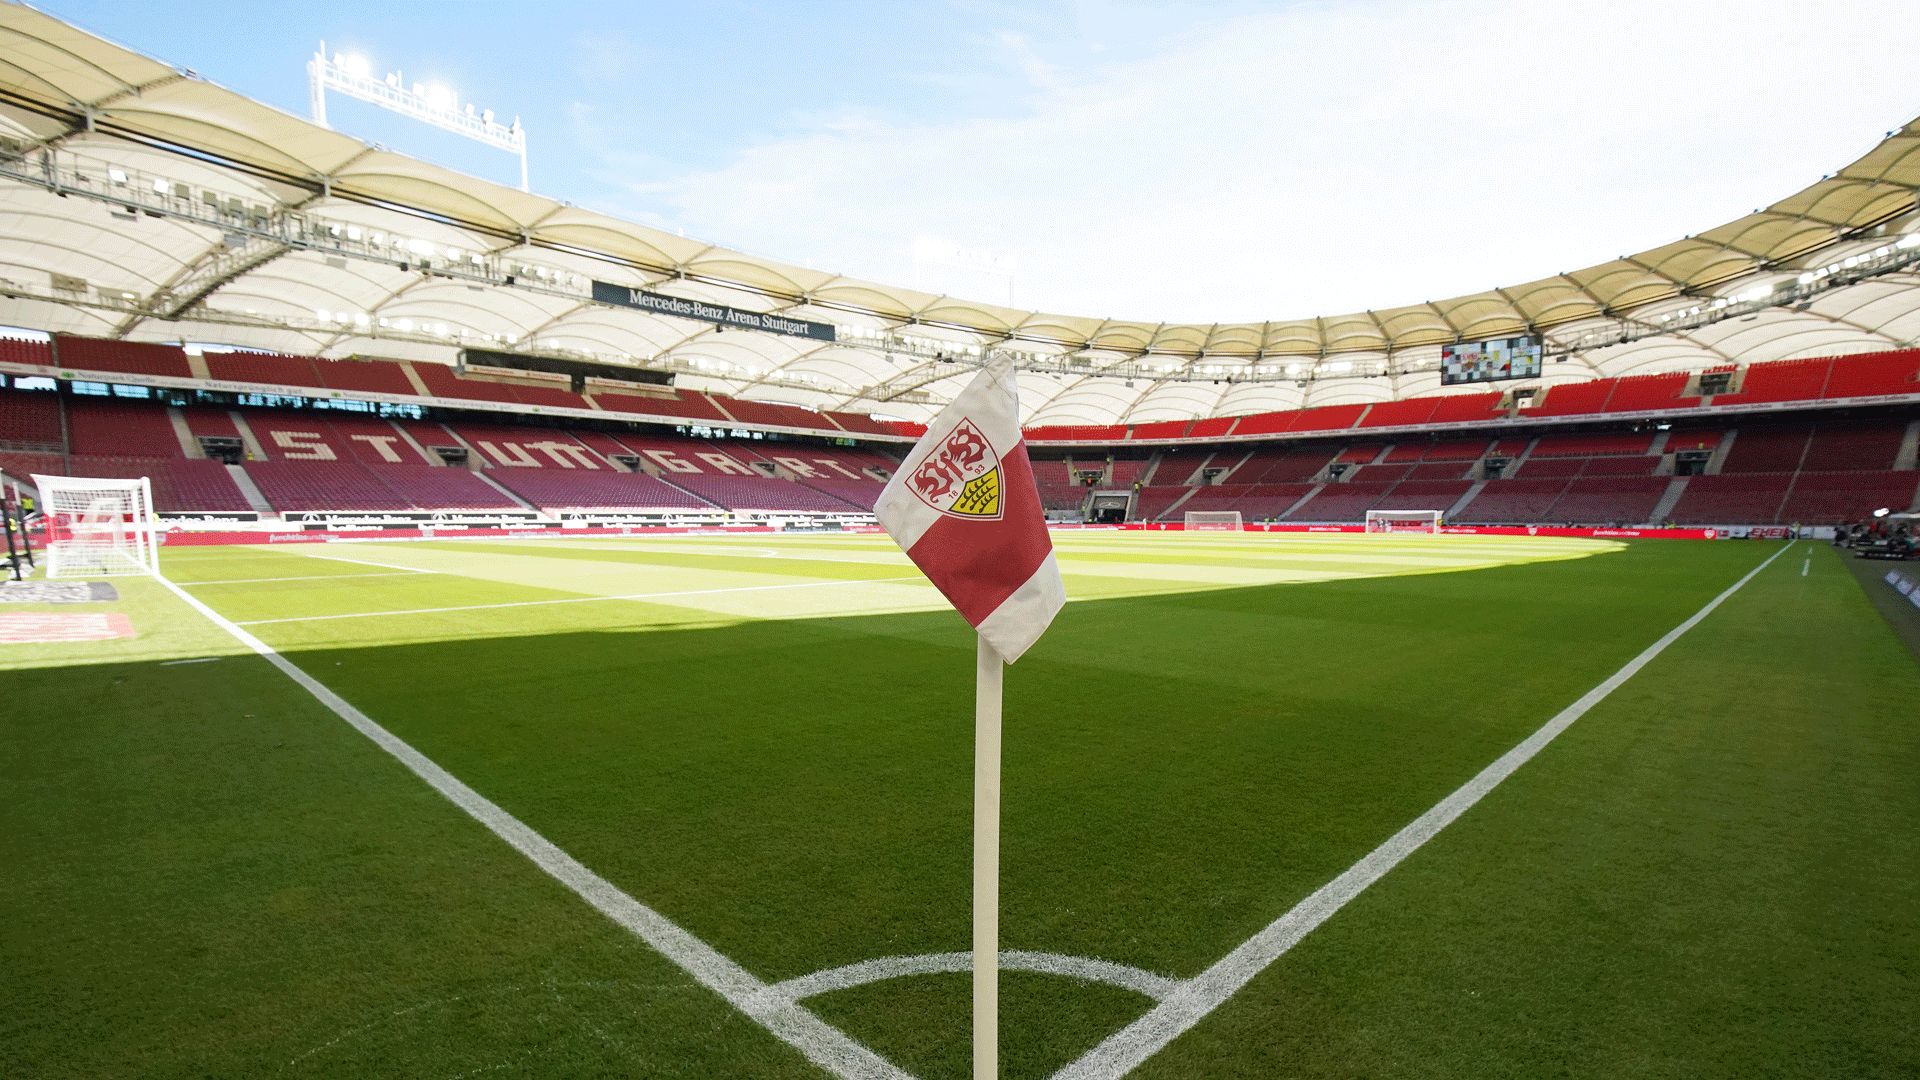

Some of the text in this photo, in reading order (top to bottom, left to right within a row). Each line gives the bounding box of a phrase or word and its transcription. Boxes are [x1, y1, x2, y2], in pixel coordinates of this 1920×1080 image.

[629, 289, 809, 334] Mercedes-Benz Arena Stuttgart
[974, 464, 985, 475] 93
[948, 489, 959, 500] 18
